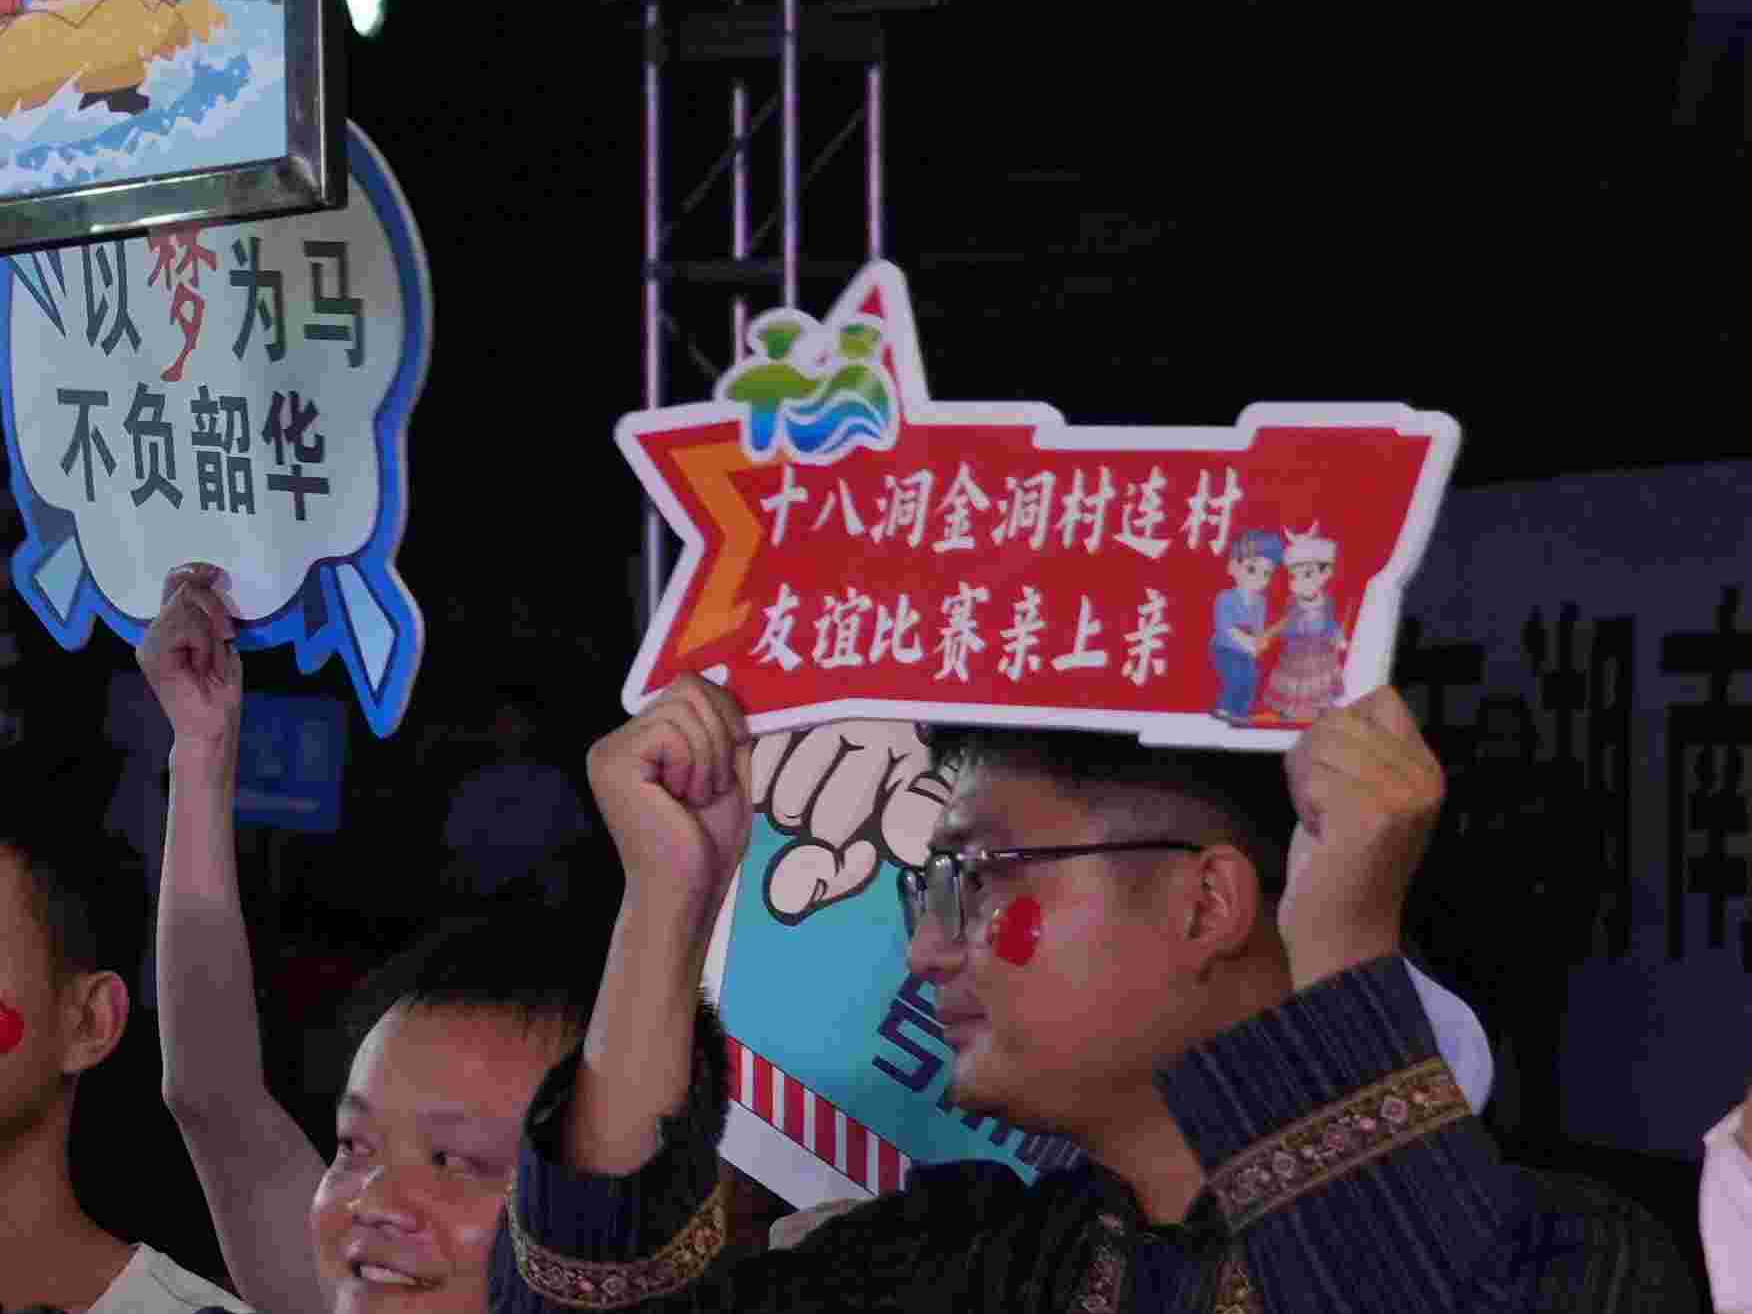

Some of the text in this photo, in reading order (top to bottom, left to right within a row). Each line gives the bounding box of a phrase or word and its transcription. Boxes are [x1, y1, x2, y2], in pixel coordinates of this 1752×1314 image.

[82, 227, 366, 383] 以梦为马
[56, 383, 330, 521] 不负韶华
[758, 465, 1243, 559] 十八洞金洞村连村
[749, 583, 1174, 686] 友谊比赛亲上亲
